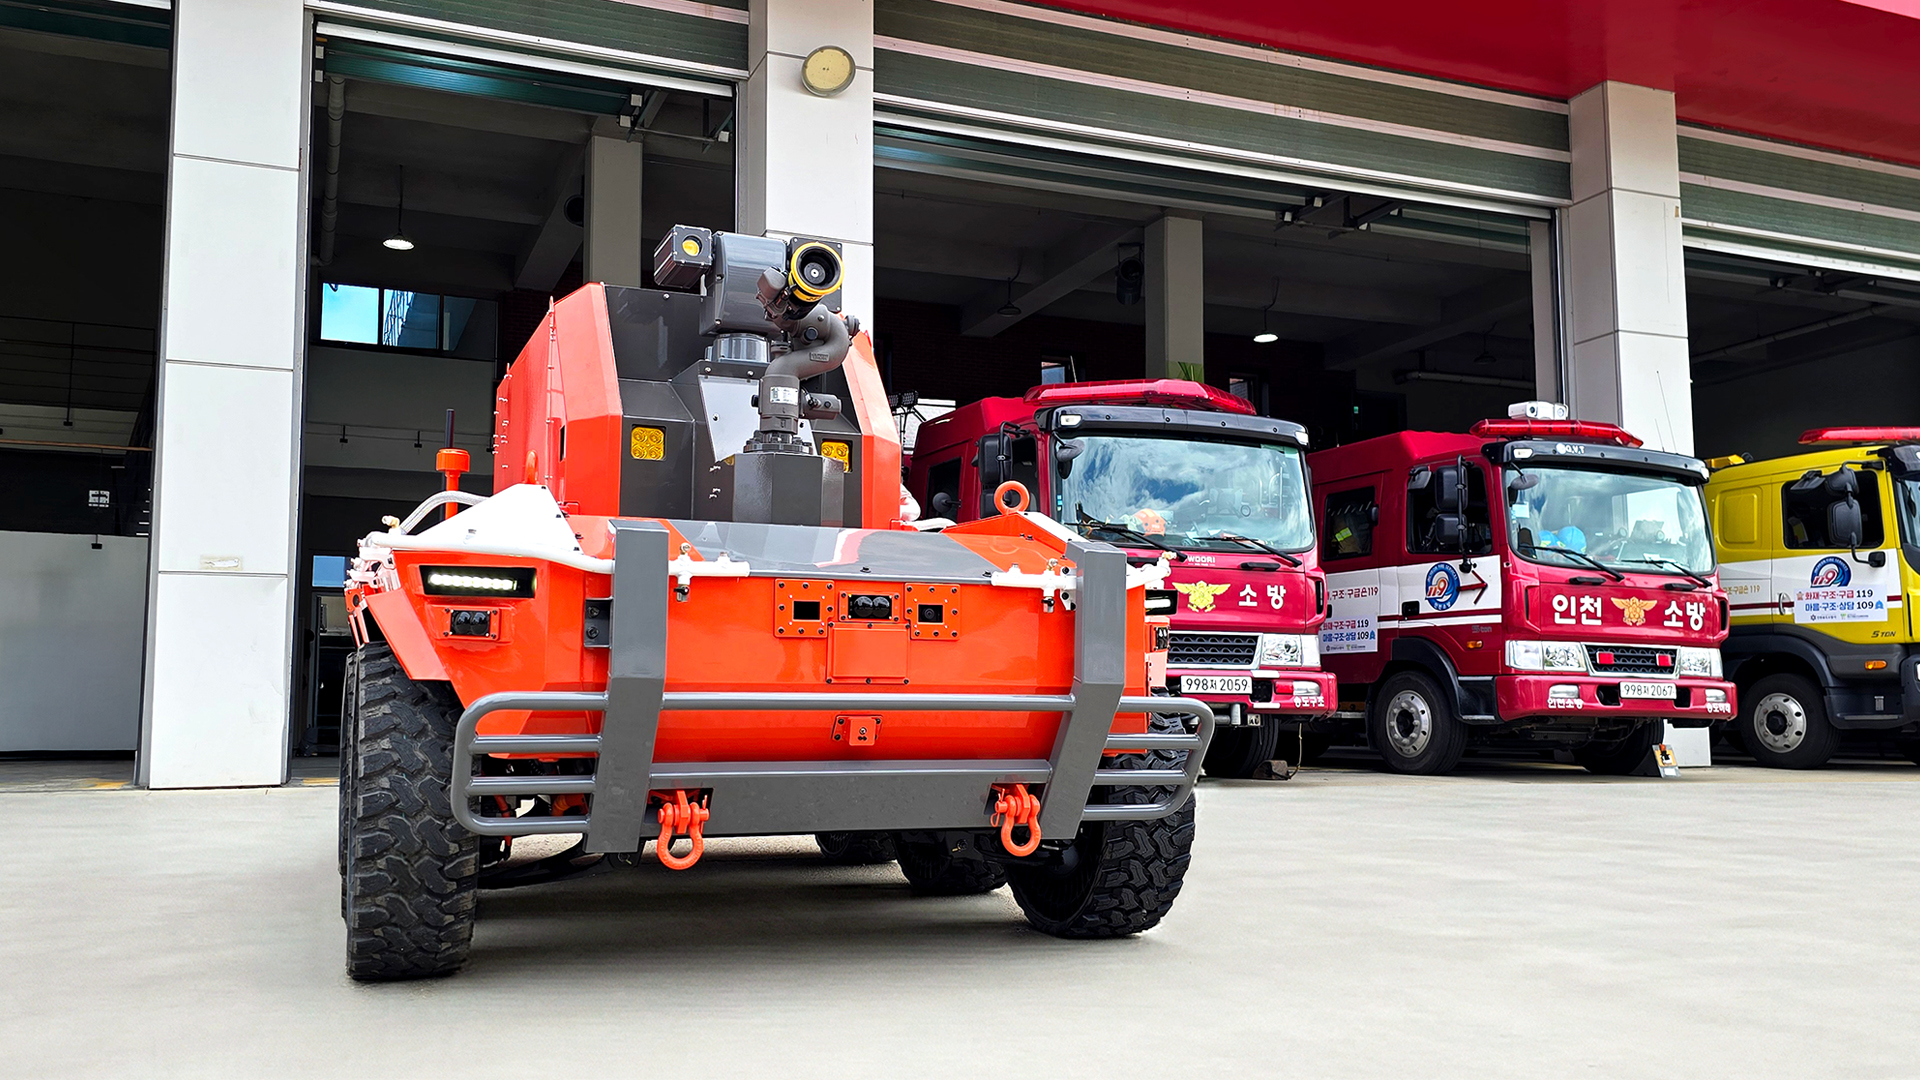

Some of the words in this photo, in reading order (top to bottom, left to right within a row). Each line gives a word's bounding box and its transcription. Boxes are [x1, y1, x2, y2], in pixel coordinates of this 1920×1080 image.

[1187, 555, 1215, 563] WOORI
[1812, 570, 1836, 585] 119
[1427, 579, 1447, 597] 119
[1856, 589, 1873, 598] 119
[1238, 584, 1286, 610] 소방
[1856, 601, 1874, 609] 109
[1552, 594, 1602, 626] 인천
[1663, 600, 1706, 631] 소방
[1357, 619, 1369, 628] 119
[1357, 631, 1369, 640] 109
[1186, 678, 1217, 690] 998저
[1219, 678, 1248, 691] 2059
[1650, 685, 1673, 696] 2067
[1547, 698, 1583, 710] 인천소방
